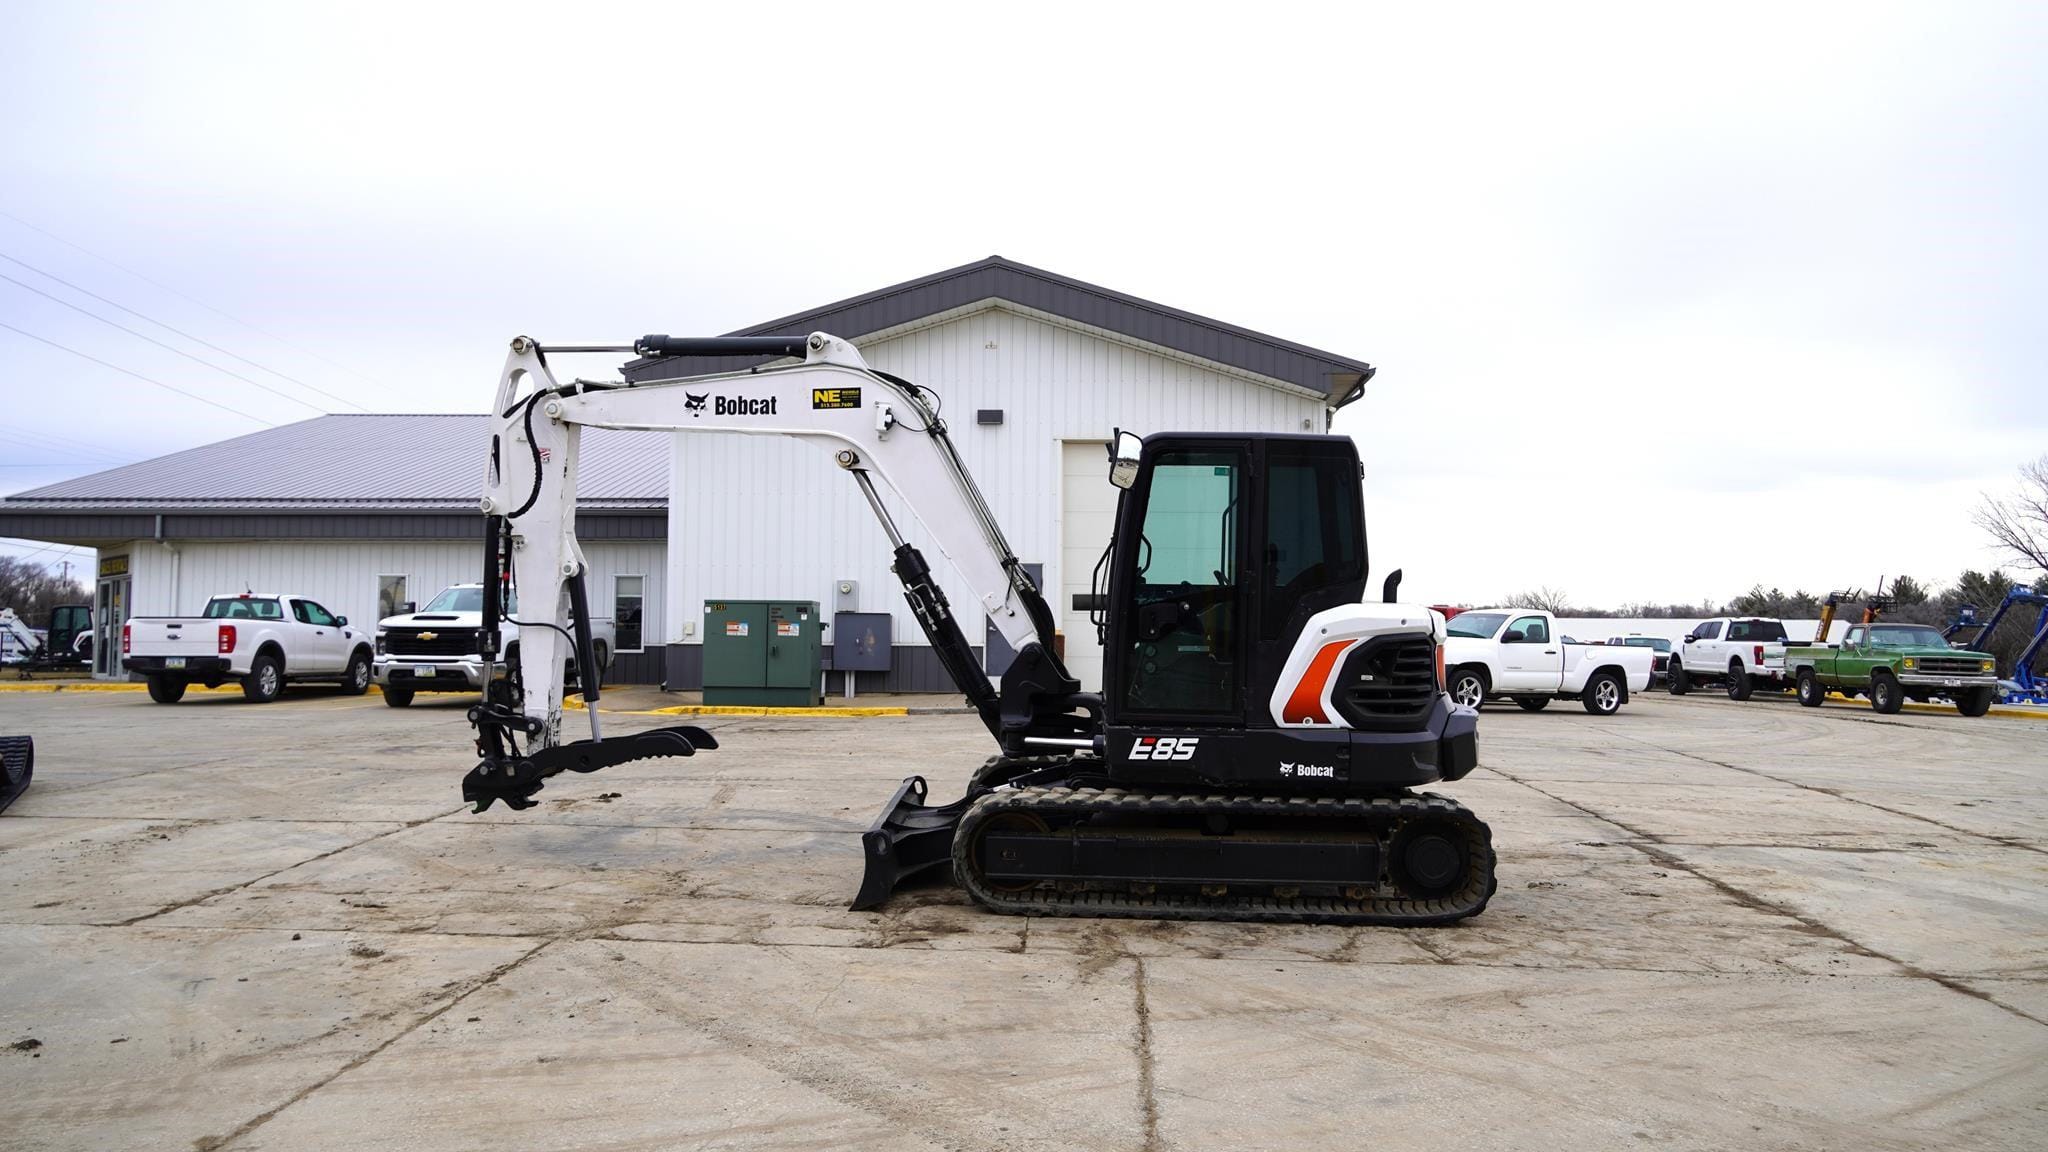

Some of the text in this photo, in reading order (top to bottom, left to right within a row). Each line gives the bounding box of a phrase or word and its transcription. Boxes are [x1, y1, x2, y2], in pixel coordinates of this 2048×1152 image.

[814, 390, 841, 403] NE
[715, 396, 777, 415] Bobcat
[1128, 737, 1200, 760] E85
[1297, 764, 1334, 778] Bobcat
